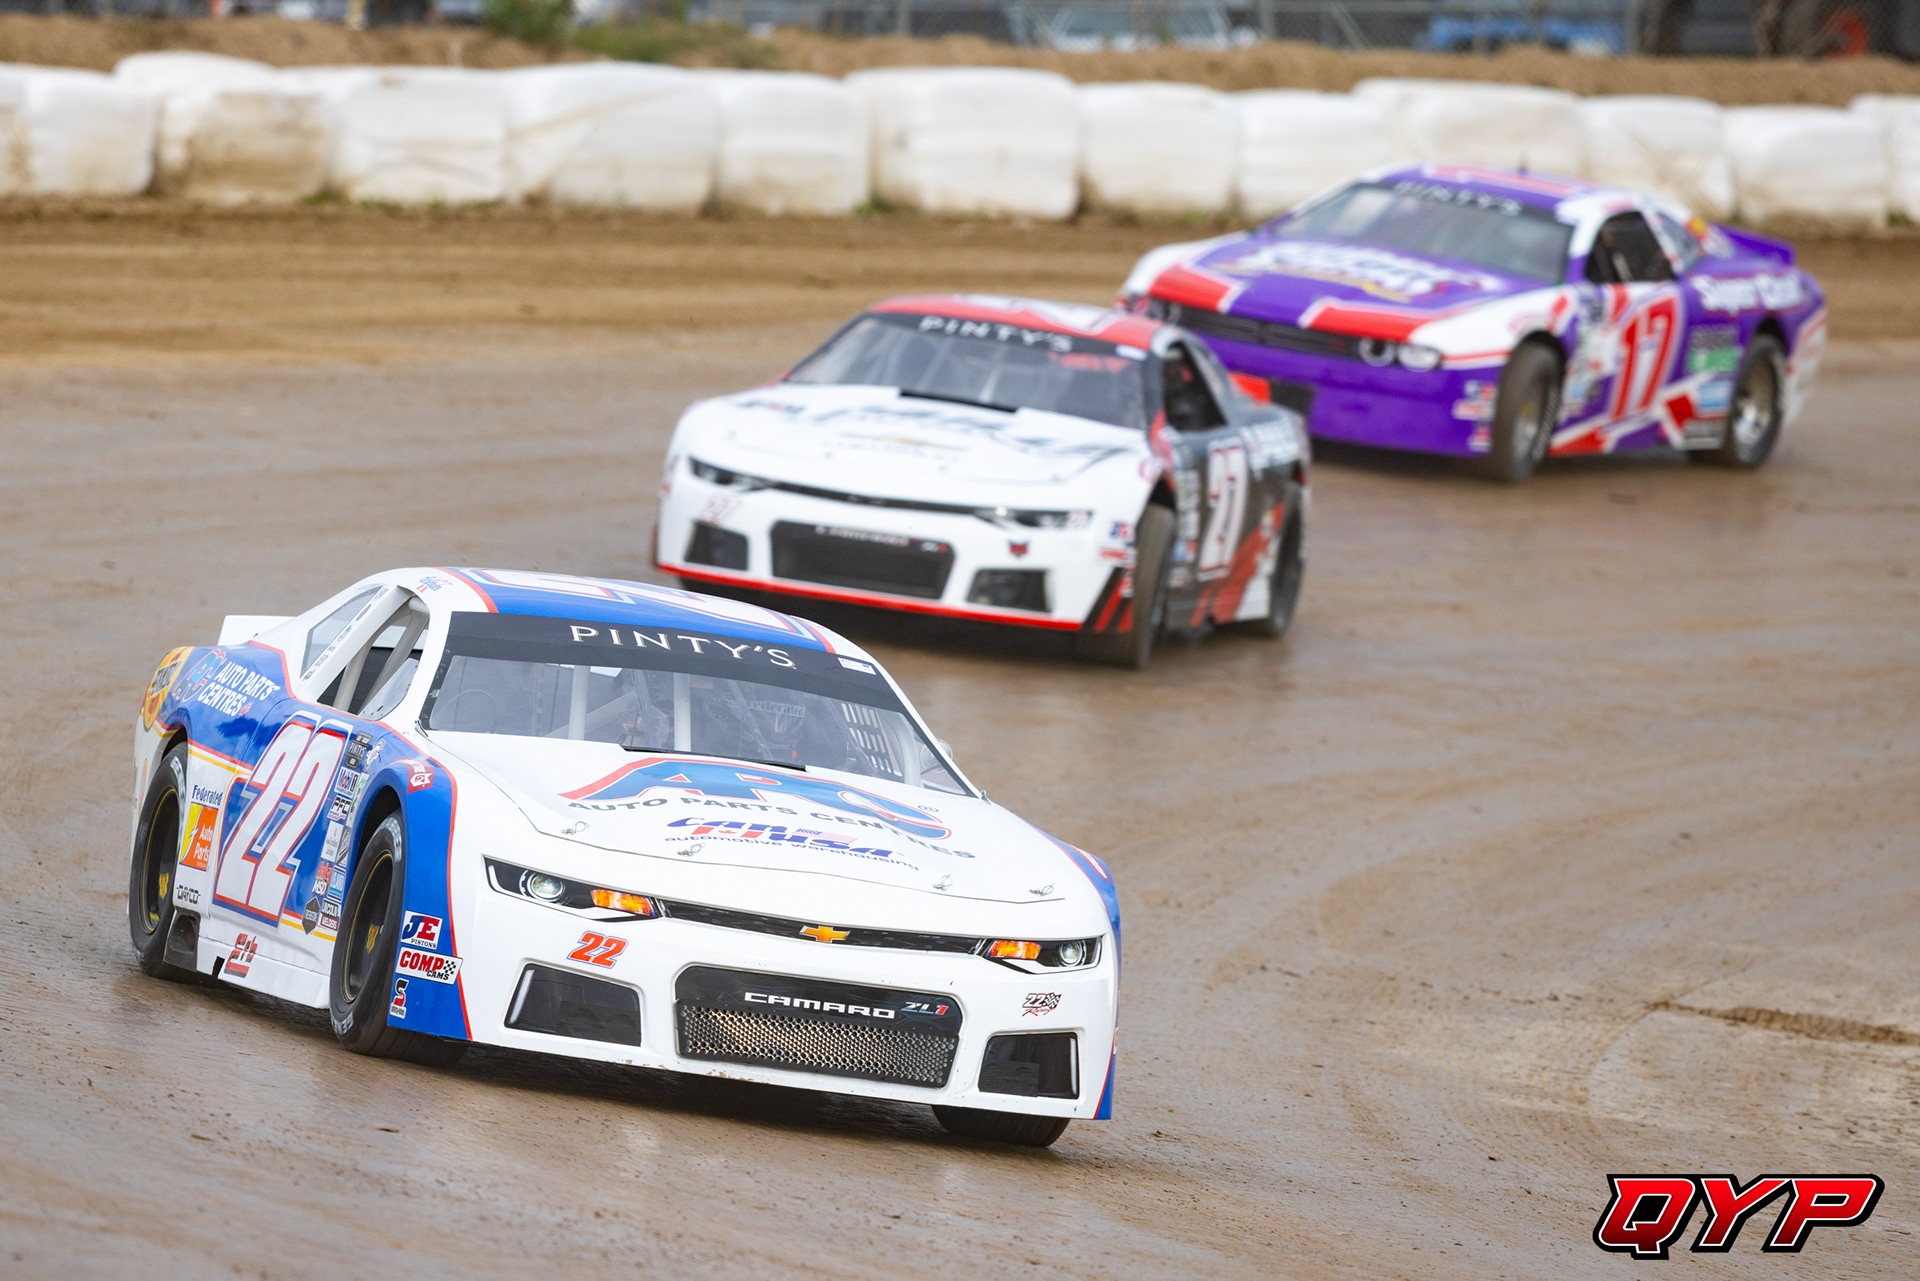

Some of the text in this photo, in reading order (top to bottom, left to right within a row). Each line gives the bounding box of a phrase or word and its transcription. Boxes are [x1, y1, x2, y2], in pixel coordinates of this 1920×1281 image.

[919, 314, 1074, 353] PINTY'S
[1608, 296, 1678, 424] 17
[569, 625, 797, 670] PINTY'S
[214, 661, 248, 689] AUTO
[240, 671, 281, 701] PARTS
[198, 682, 248, 717] CENTRES
[338, 768, 352, 790] Mobil
[192, 784, 224, 806] Federated
[558, 757, 952, 840] APC
[199, 823, 213, 843] Auto
[212, 712, 351, 927] 22
[568, 797, 976, 859] AUTO PARTS CENTRES
[193, 841, 210, 862] Parts
[665, 835, 919, 871] automotive warehousing
[321, 900, 339, 917] LINCOLN
[401, 914, 440, 942] JE
[410, 938, 437, 949] PISTONS
[567, 930, 628, 969] 22
[399, 950, 445, 973] COMP
[426, 969, 450, 981] CAMS
[744, 990, 949, 1019] CAMARO ZL1
[1022, 992, 1046, 1009] 22
